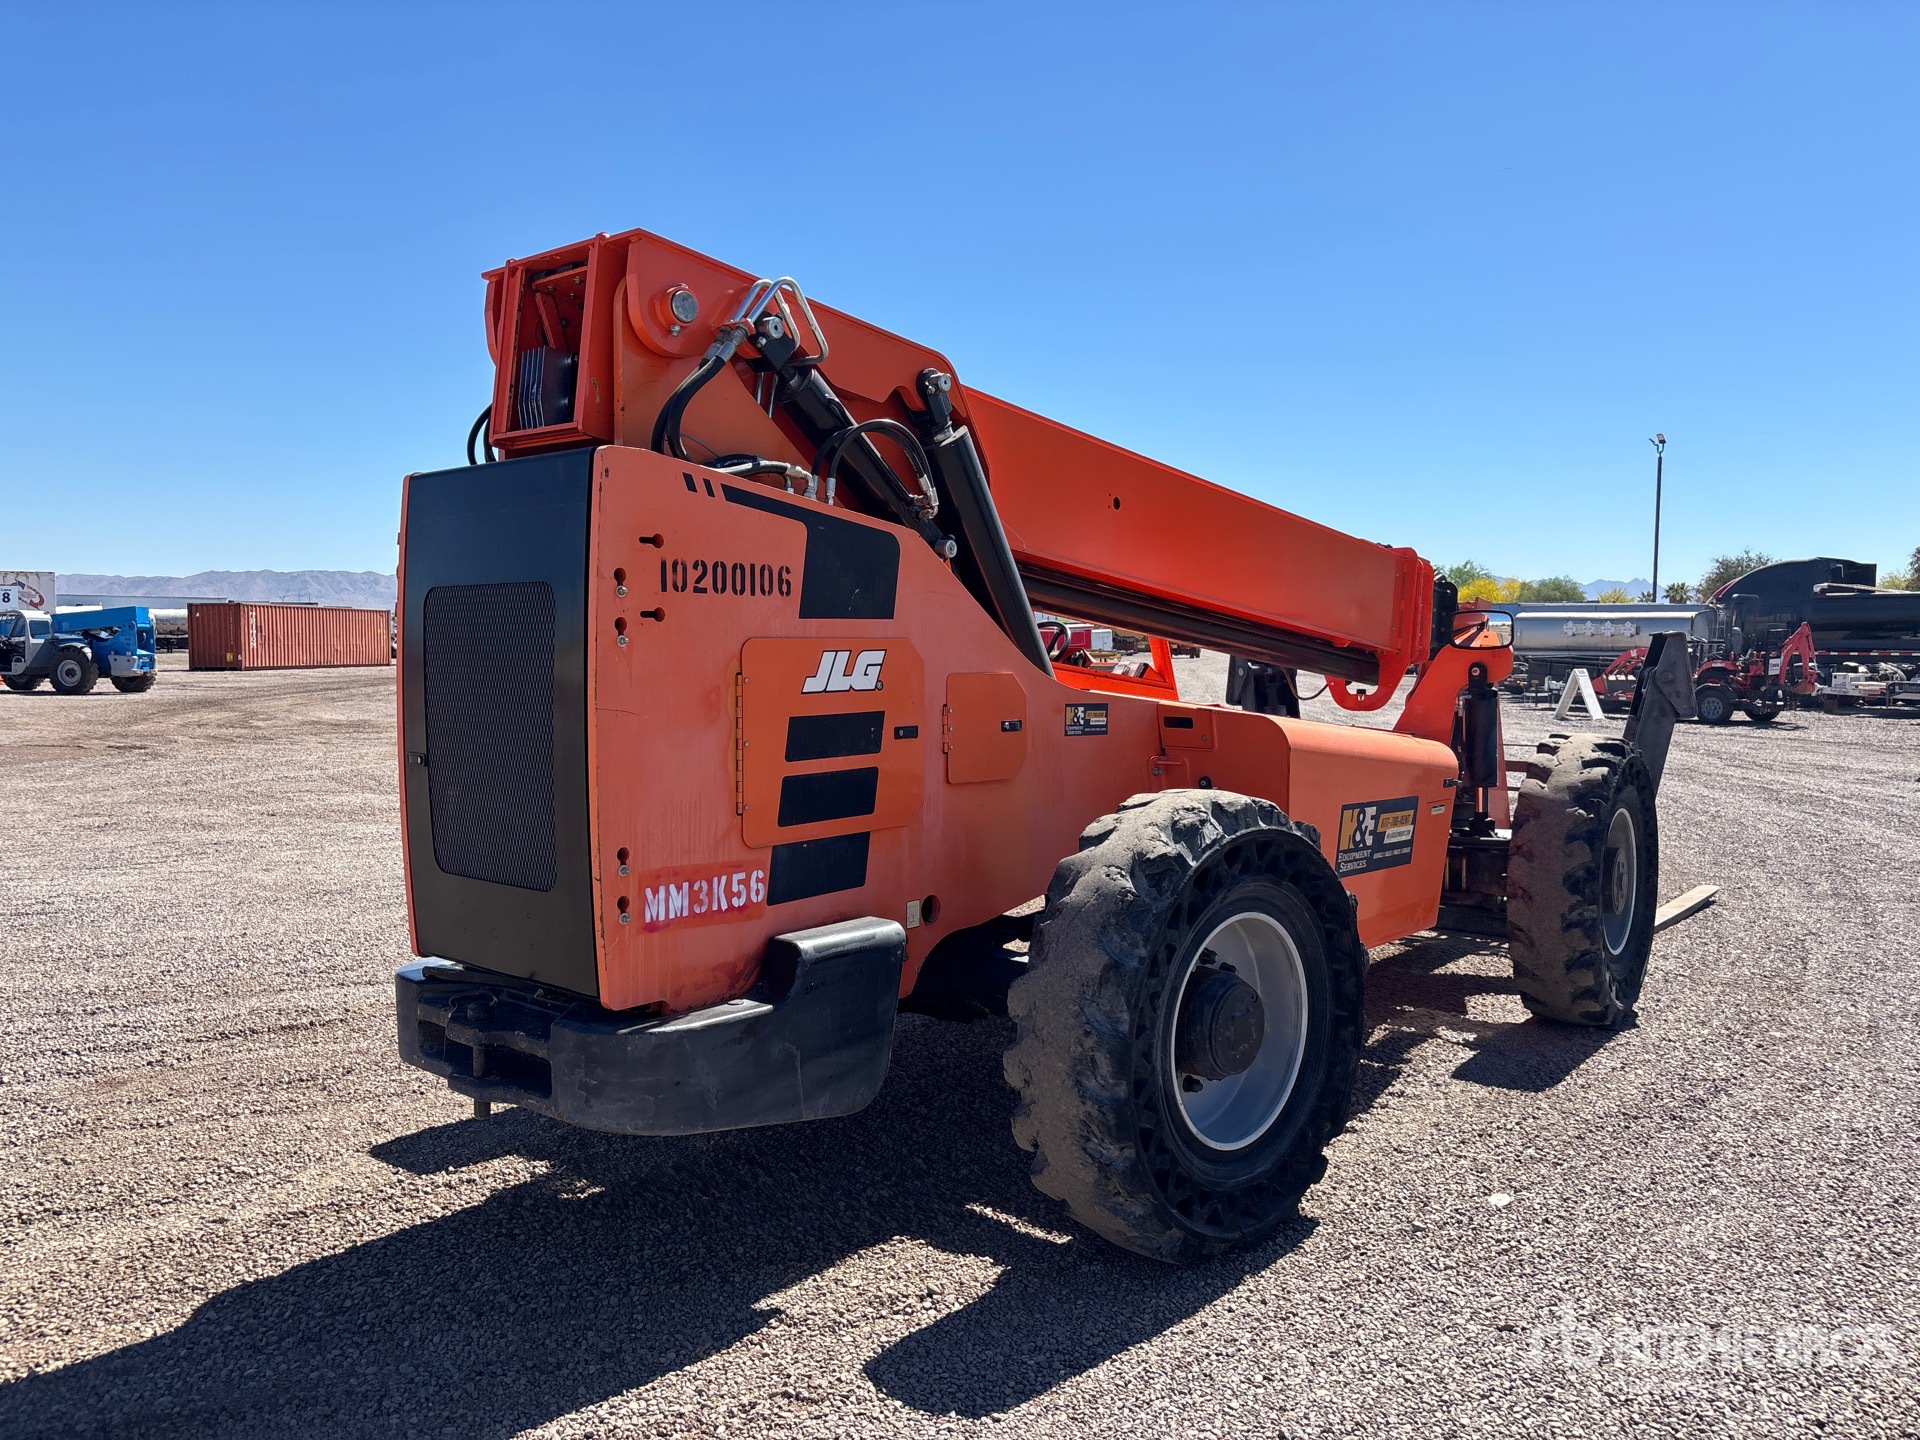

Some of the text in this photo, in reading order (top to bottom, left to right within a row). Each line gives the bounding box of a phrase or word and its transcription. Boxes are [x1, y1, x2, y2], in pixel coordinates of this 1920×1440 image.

[660, 558, 792, 597] 10200106
[2, 592, 10, 603] 8
[801, 649, 887, 694] JLG
[1066, 706, 1085, 725] H&E
[1340, 806, 1377, 850] H&E
[1338, 849, 1372, 863] EQUIPMENT
[1340, 860, 1367, 873] SERVICES
[644, 869, 765, 923] MM3K56
